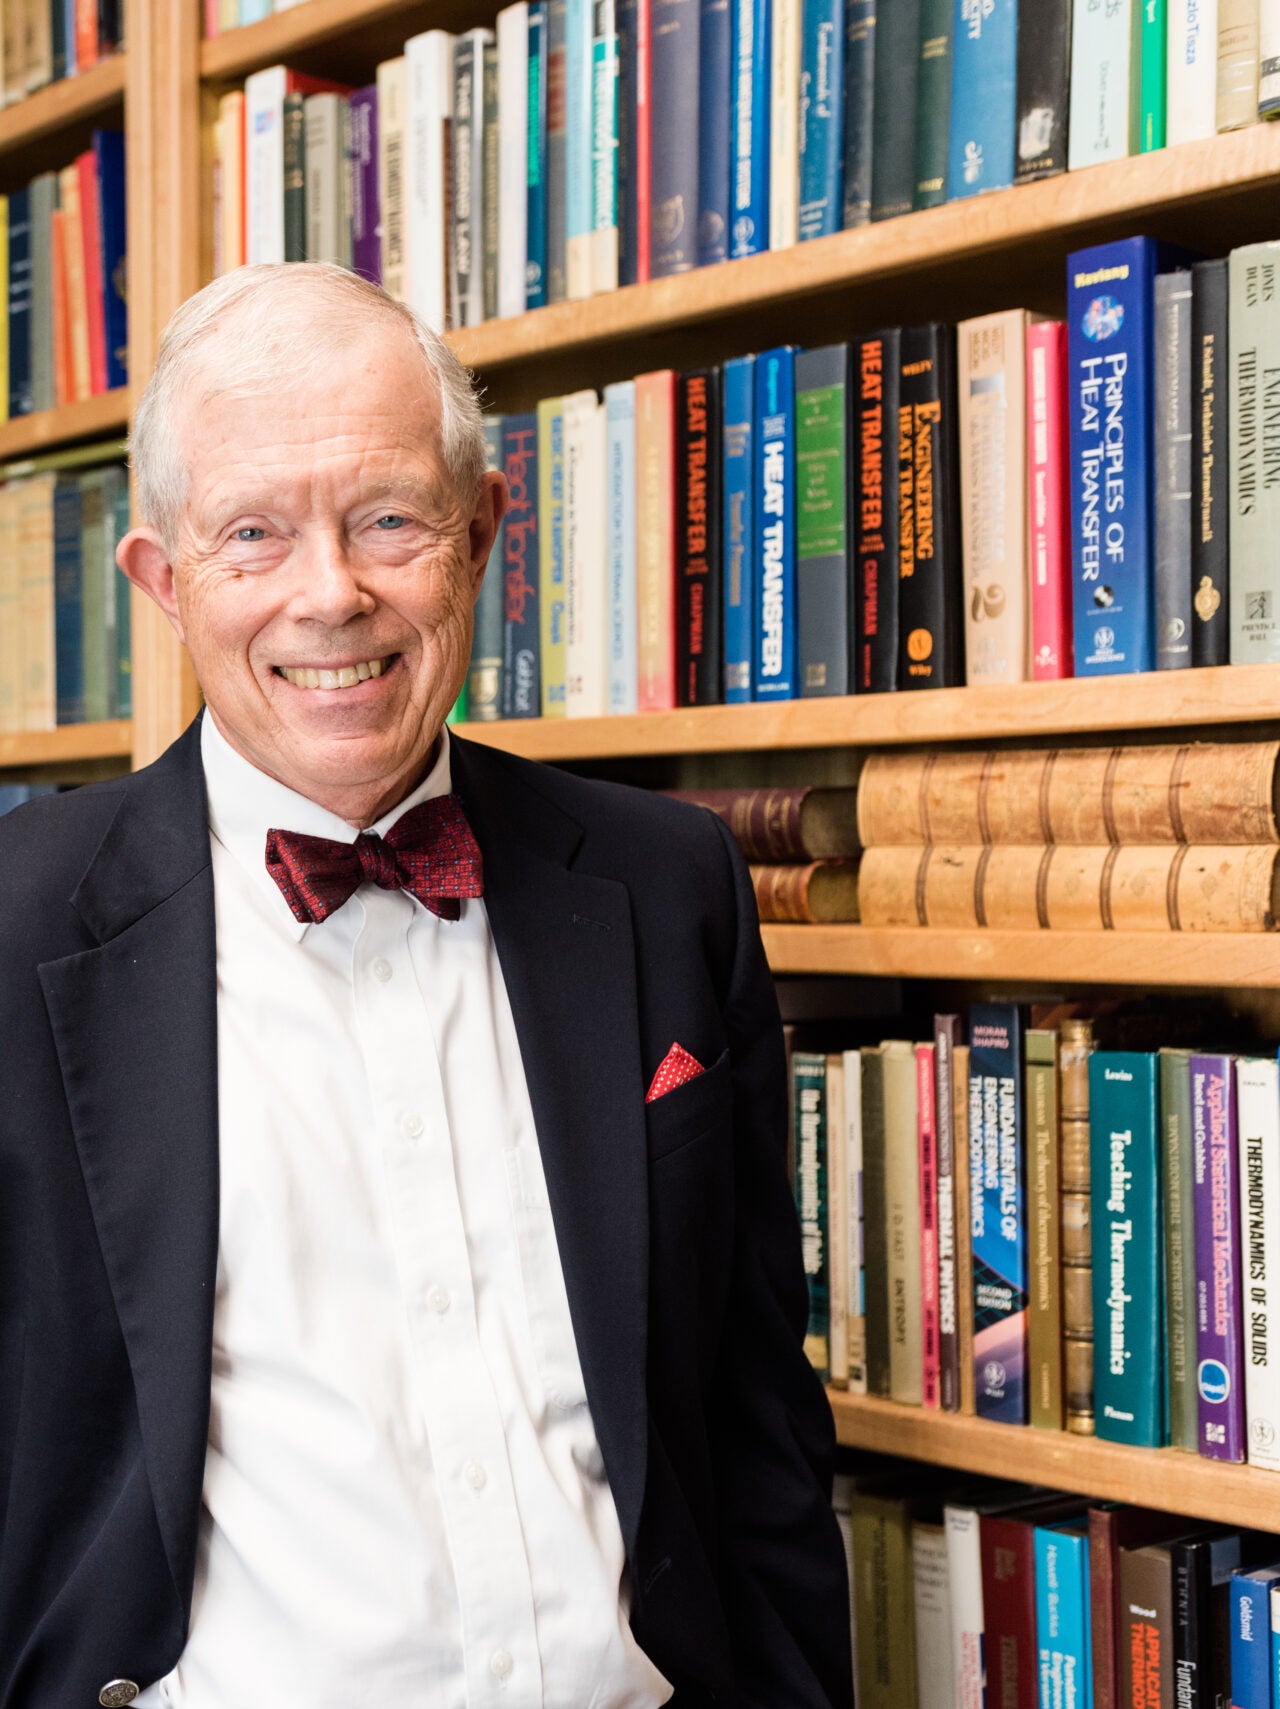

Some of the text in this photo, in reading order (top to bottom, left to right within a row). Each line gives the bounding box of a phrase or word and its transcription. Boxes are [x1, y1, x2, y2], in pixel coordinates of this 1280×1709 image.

[1245, 267, 1258, 307] DUGAN
[1261, 264, 1274, 302] JONES
[686, 377, 706, 433] HEAT
[860, 340, 882, 400] HEAT
[1080, 359, 1101, 431] HEAT
[861, 404, 883, 530] TRANSFER
[1103, 352, 1127, 563] PRINCIPLES OF
[1238, 347, 1257, 516] THERMODYNAMICS
[1261, 368, 1280, 489] ENGINEERING
[505, 429, 534, 515] Heat
[687, 436, 707, 554] TRANSFER
[763, 441, 784, 516] HEAT
[899, 405, 914, 578] HEAT TRANSFER
[913, 400, 941, 559] ENGINEERING
[1082, 440, 1104, 581] TRANSFER
[689, 583, 703, 654] CHAPMAN
[762, 520, 784, 676] TRANSFER
[863, 560, 878, 635] CHAPMAN
[971, 584, 1006, 623] 2
[973, 1025, 1008, 1037] MORAN
[973, 1037, 1010, 1049] SHAPIRO
[969, 1075, 984, 1237] THERMODYNAMICS
[983, 1077, 999, 1189] ENGINEERING
[999, 1077, 1016, 1241] FUNDAMENTALS OF
[1168, 1114, 1181, 1225] THERMODYNAMIK
[1194, 1073, 1206, 1184] Reed and Gubbins
[1035, 1153, 1050, 1191] theory
[1038, 1194, 1051, 1210] of
[1208, 1074, 1232, 1336] Applied Statistical Mechanics
[937, 1175, 952, 1258] THERMAL
[1106, 1130, 1133, 1375] Teaching Thermodynamics
[1247, 1136, 1267, 1367] THERMODYNAMICS OF SOLIDS
[939, 1260, 954, 1334] PHYSICS
[977, 1284, 1013, 1300] SECOND
[1037, 1211, 1051, 1311] thermodynamics
[1171, 1231, 1183, 1311] CHEMISCHE
[894, 1279, 906, 1347] ENTROPY
[977, 1296, 1012, 1310] EDITION
[1240, 1596, 1254, 1641] Goldsmid
